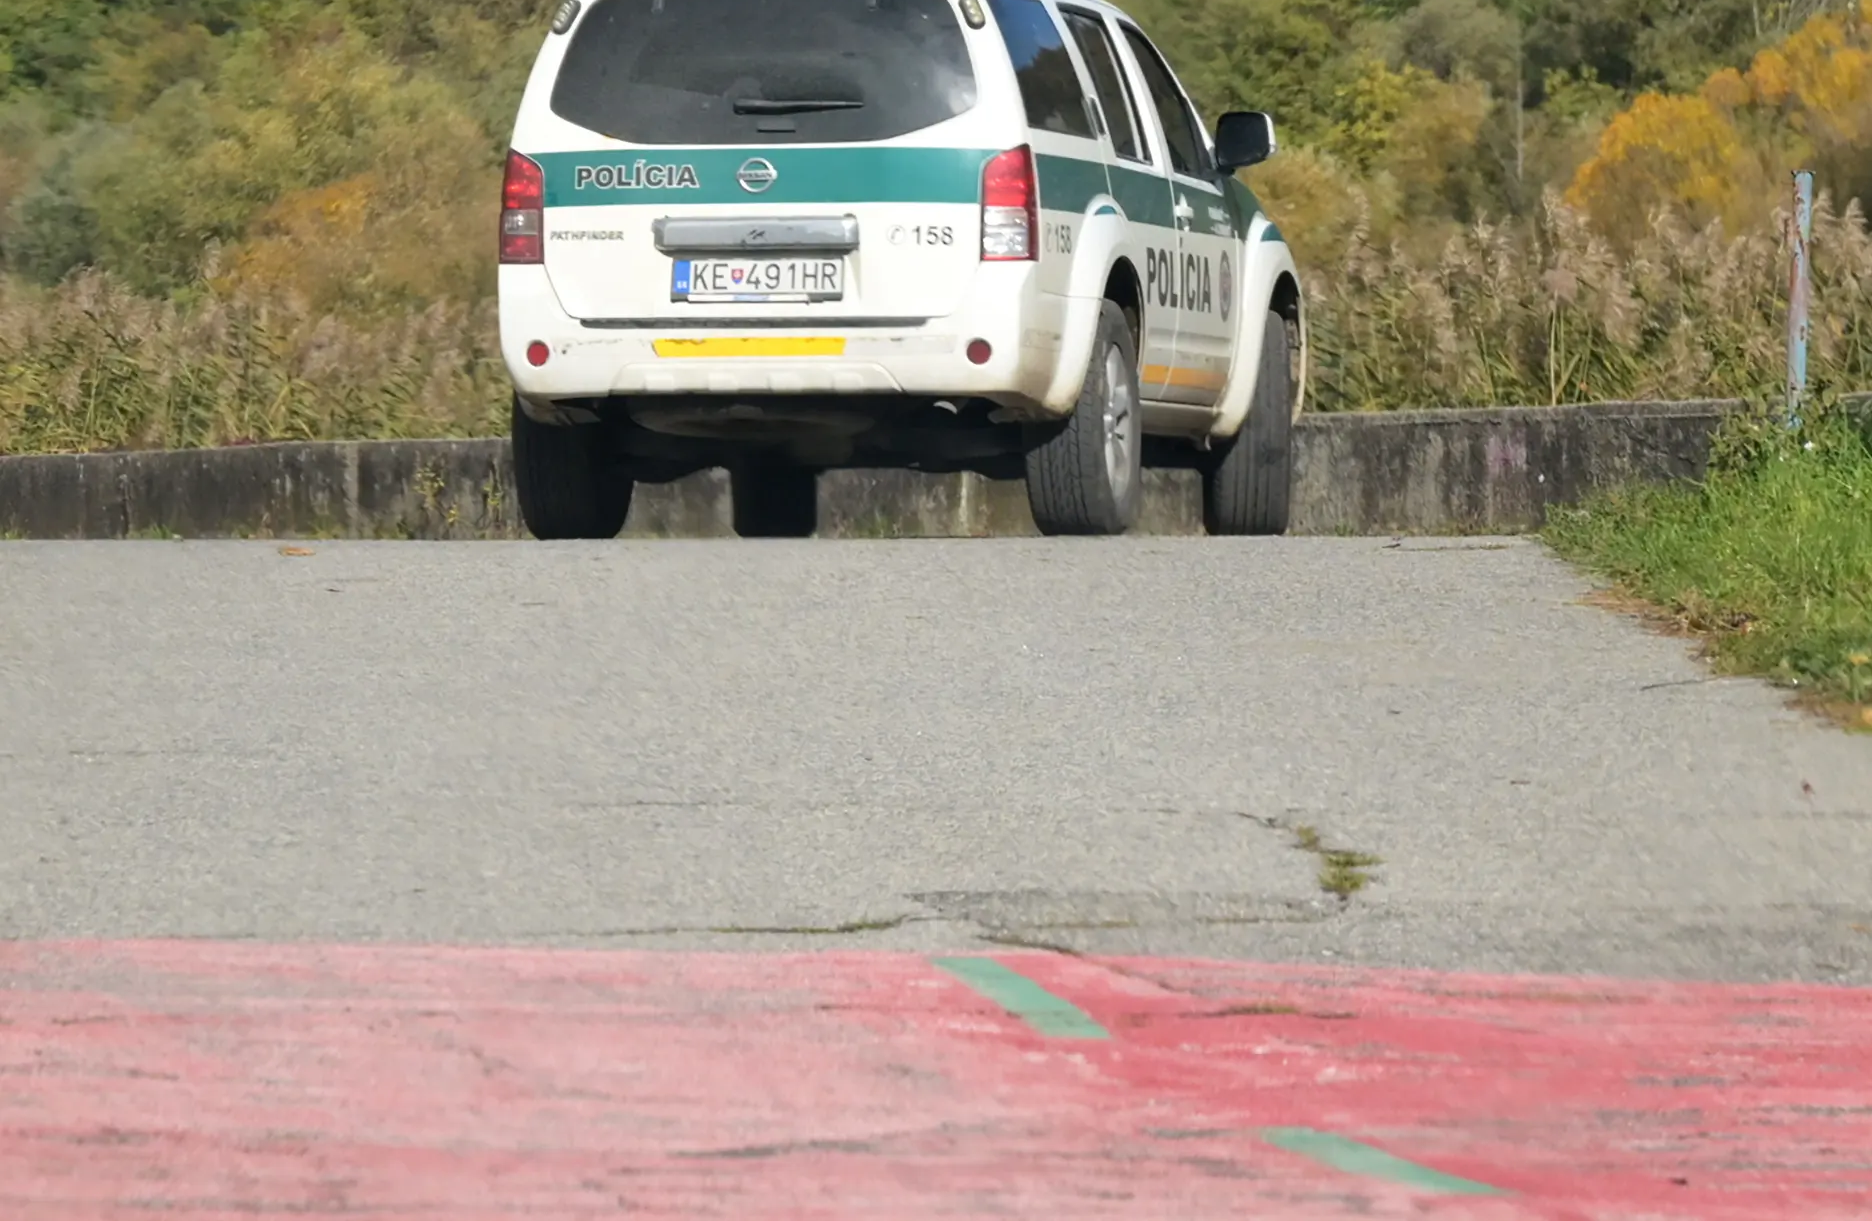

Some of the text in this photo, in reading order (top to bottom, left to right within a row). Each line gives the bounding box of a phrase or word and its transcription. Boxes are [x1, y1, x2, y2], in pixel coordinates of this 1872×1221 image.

[574, 159, 700, 189] POLÍCIA
[550, 230, 625, 241] PATHFINDER
[911, 225, 954, 246] 158
[1055, 224, 1073, 254] 158
[693, 263, 838, 290] KE 491HR
[1146, 237, 1212, 314] POLÍCIA
